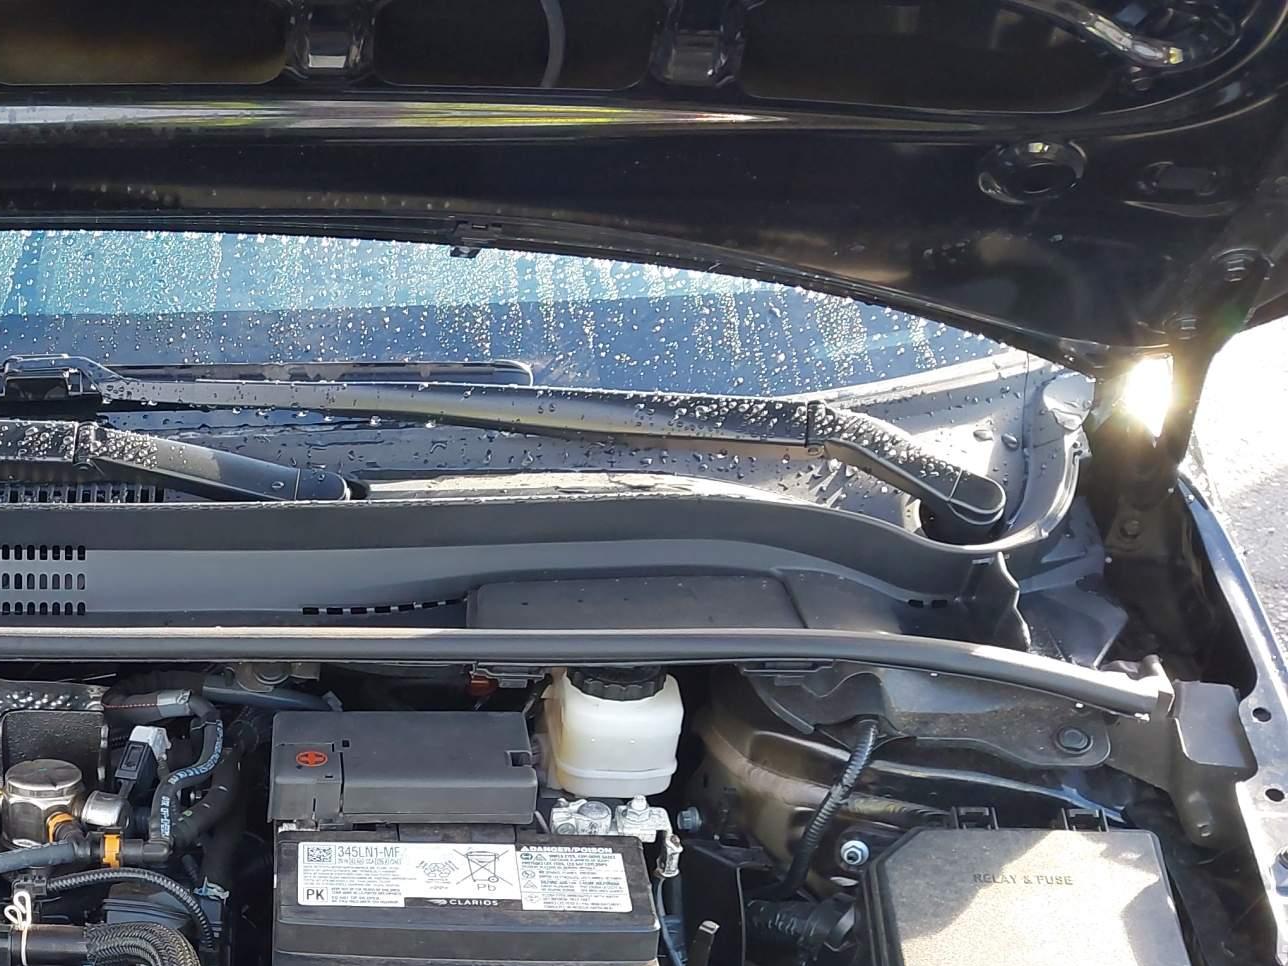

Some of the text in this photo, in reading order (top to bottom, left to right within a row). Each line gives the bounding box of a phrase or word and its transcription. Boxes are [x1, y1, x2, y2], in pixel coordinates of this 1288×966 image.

[338, 846, 400, 858] 345LN1-MF
[973, 873, 1073, 886] RELAY & FUSE
[476, 883, 497, 892] Pb
[306, 888, 325, 901] PK
[449, 899, 499, 907] CLARIOS
